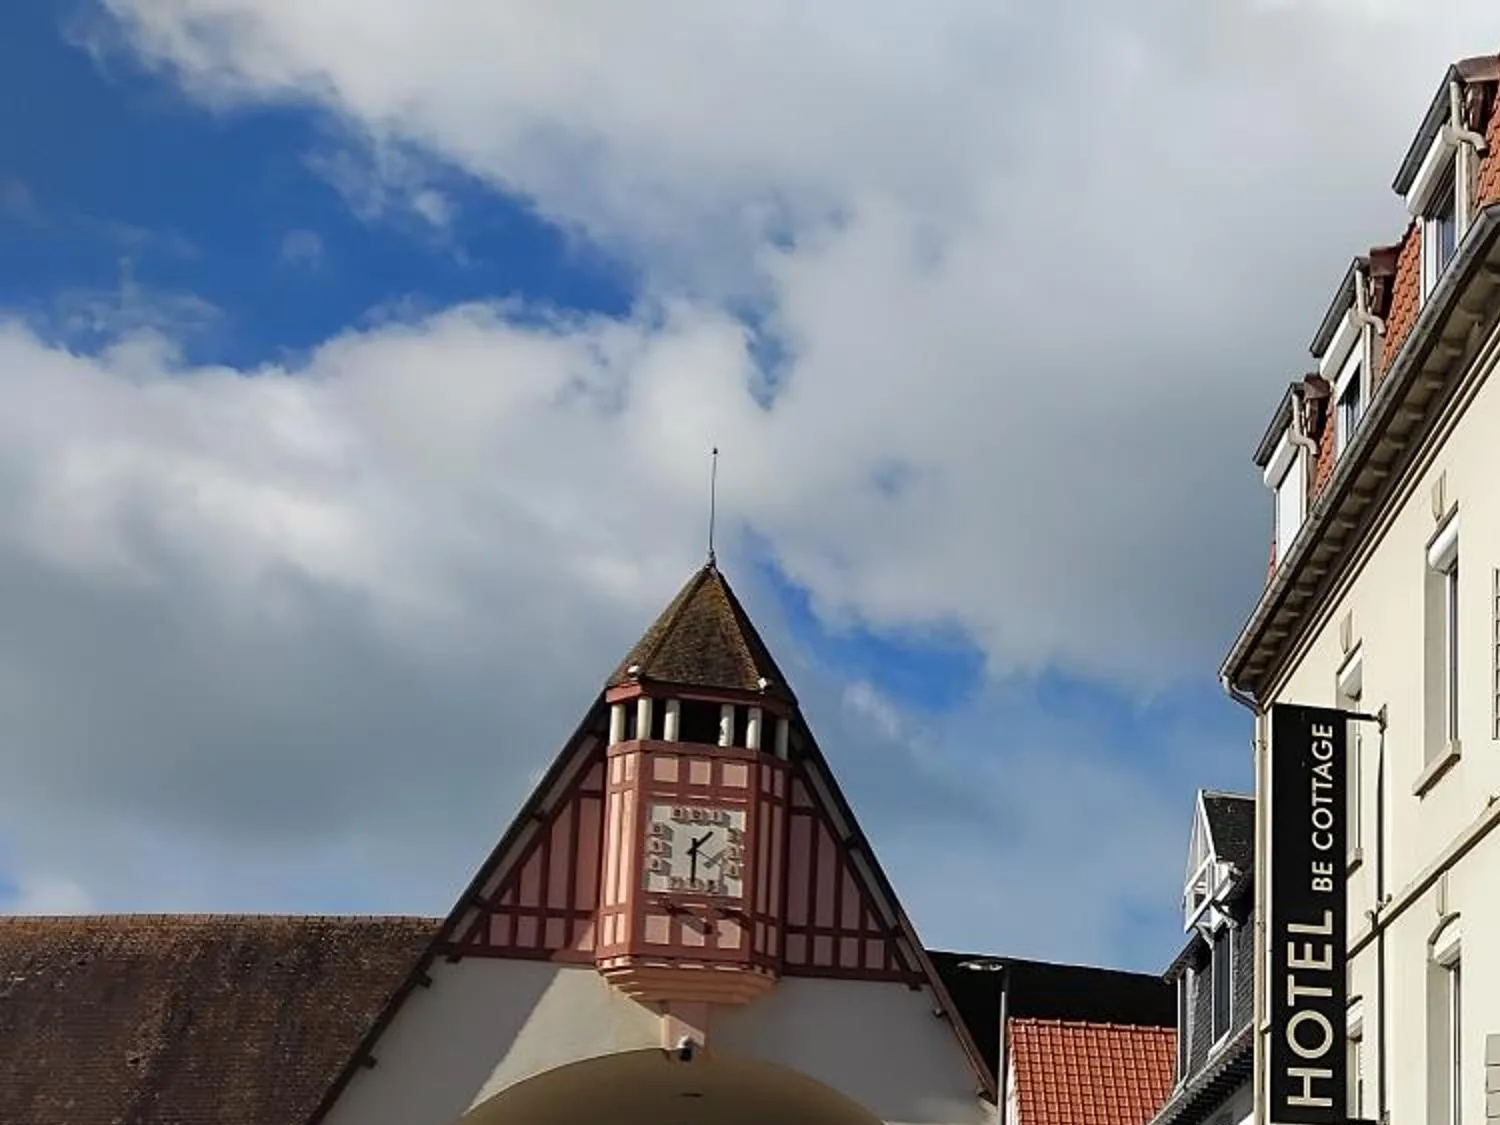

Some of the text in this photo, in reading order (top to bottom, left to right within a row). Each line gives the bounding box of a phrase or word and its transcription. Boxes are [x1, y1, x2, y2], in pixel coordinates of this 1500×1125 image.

[1287, 724, 1334, 1107] HOTEL BE COTTAGE
